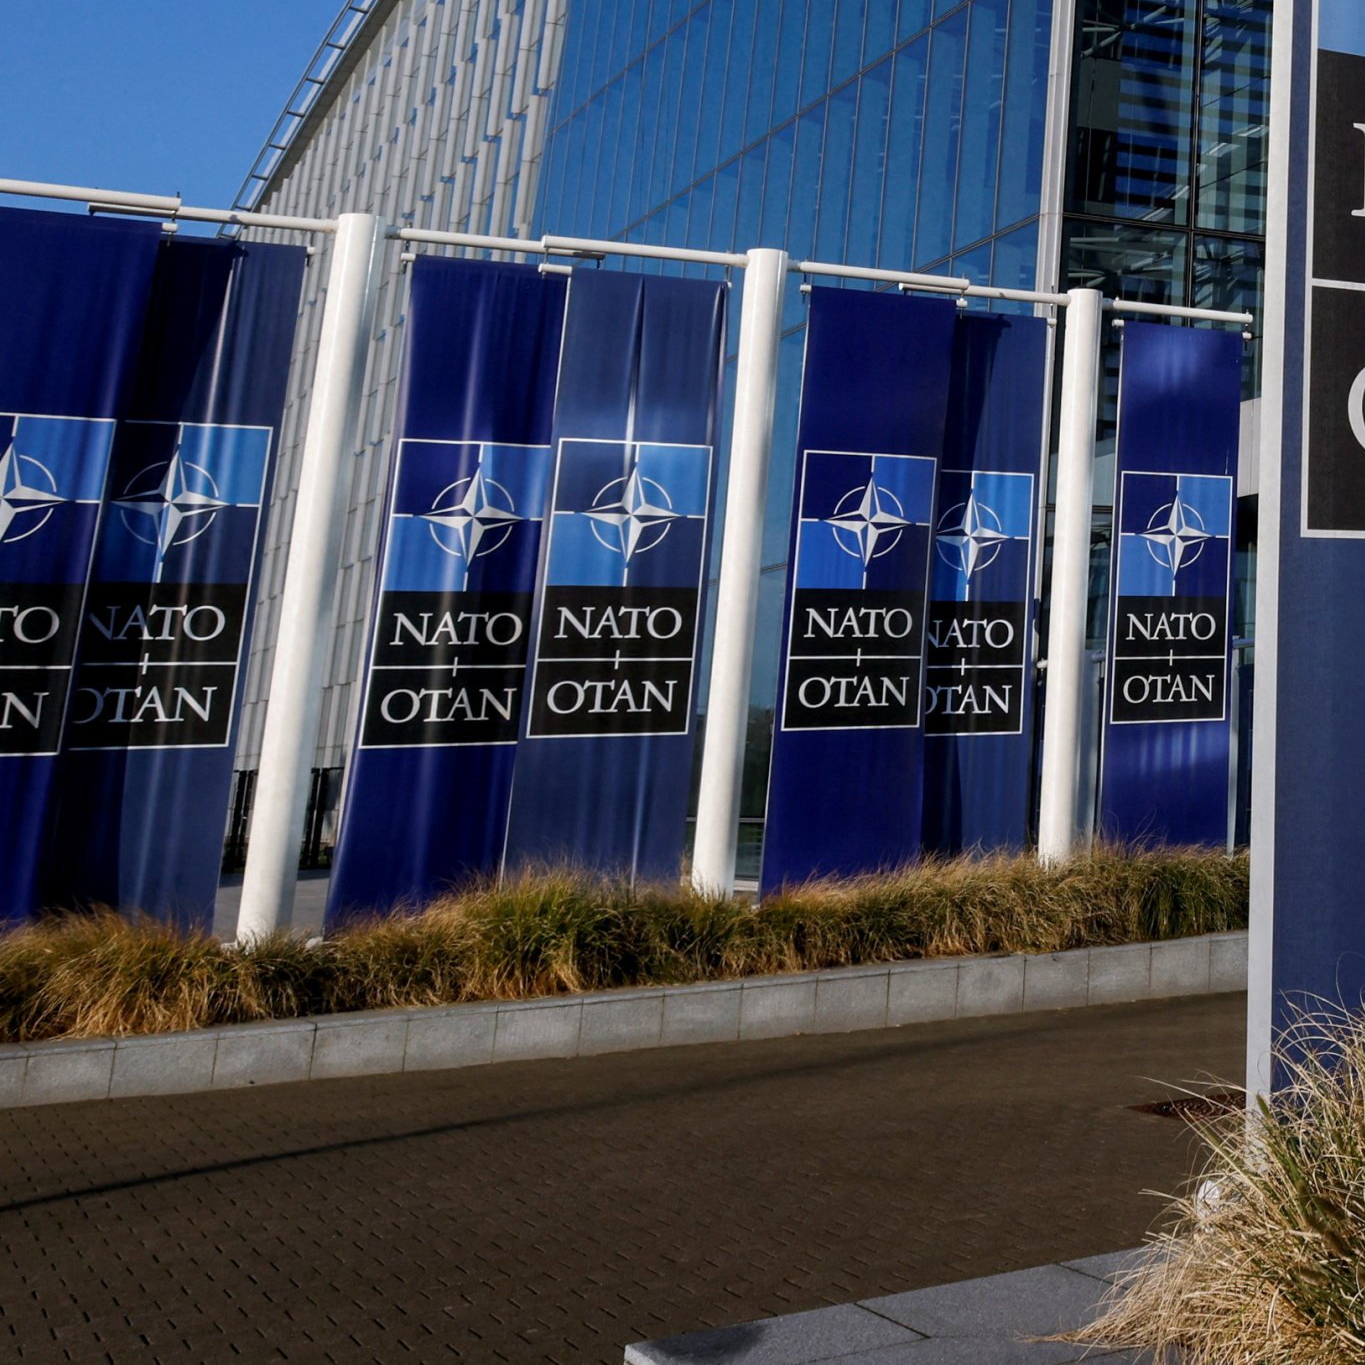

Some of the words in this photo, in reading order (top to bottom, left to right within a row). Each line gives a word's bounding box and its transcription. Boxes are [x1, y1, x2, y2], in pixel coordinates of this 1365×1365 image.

[390, 611, 522, 645] NATO
[554, 606, 682, 639] NATO
[804, 607, 912, 638] NATO
[1126, 613, 1215, 640] NATO
[547, 680, 677, 714] OTAN
[799, 676, 909, 708] OTAN
[1123, 675, 1214, 703] OTAN
[381, 688, 517, 723] OTAN
